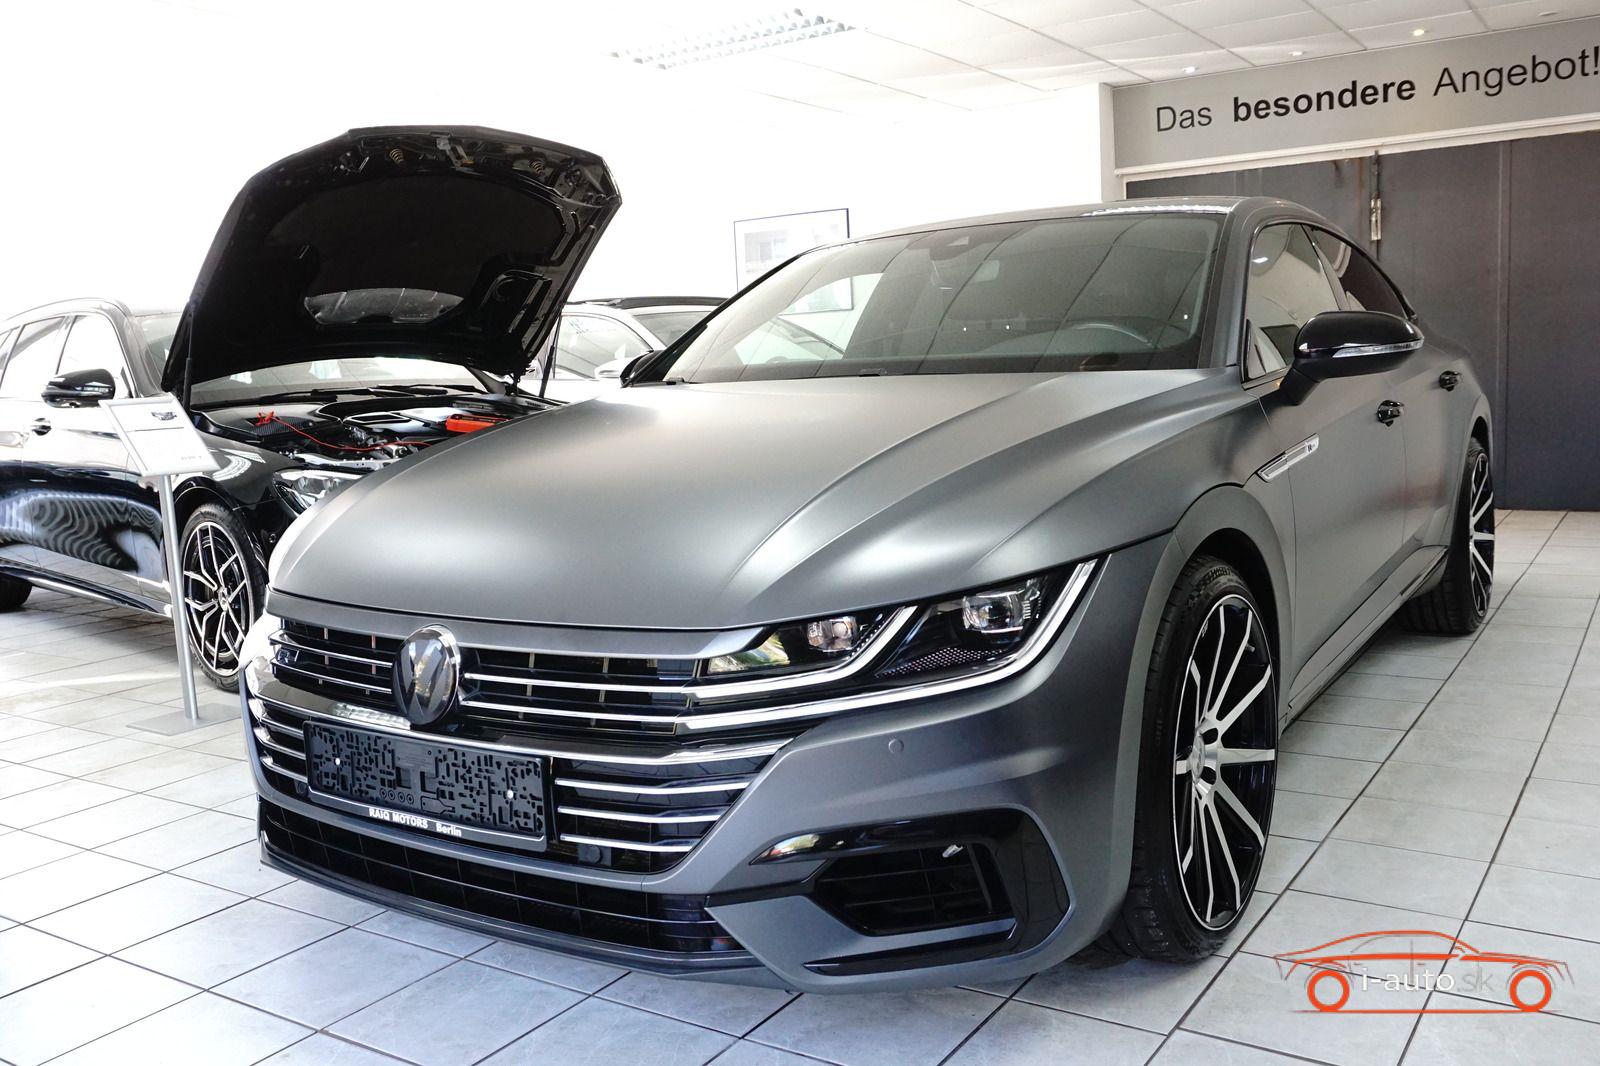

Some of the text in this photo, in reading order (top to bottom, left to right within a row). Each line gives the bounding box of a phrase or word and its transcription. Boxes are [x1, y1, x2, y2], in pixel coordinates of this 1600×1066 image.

[1156, 45, 1600, 132] Das besondere Angebot!
[392, 812, 429, 829] MOTORS
[435, 823, 463, 837] Berlin
